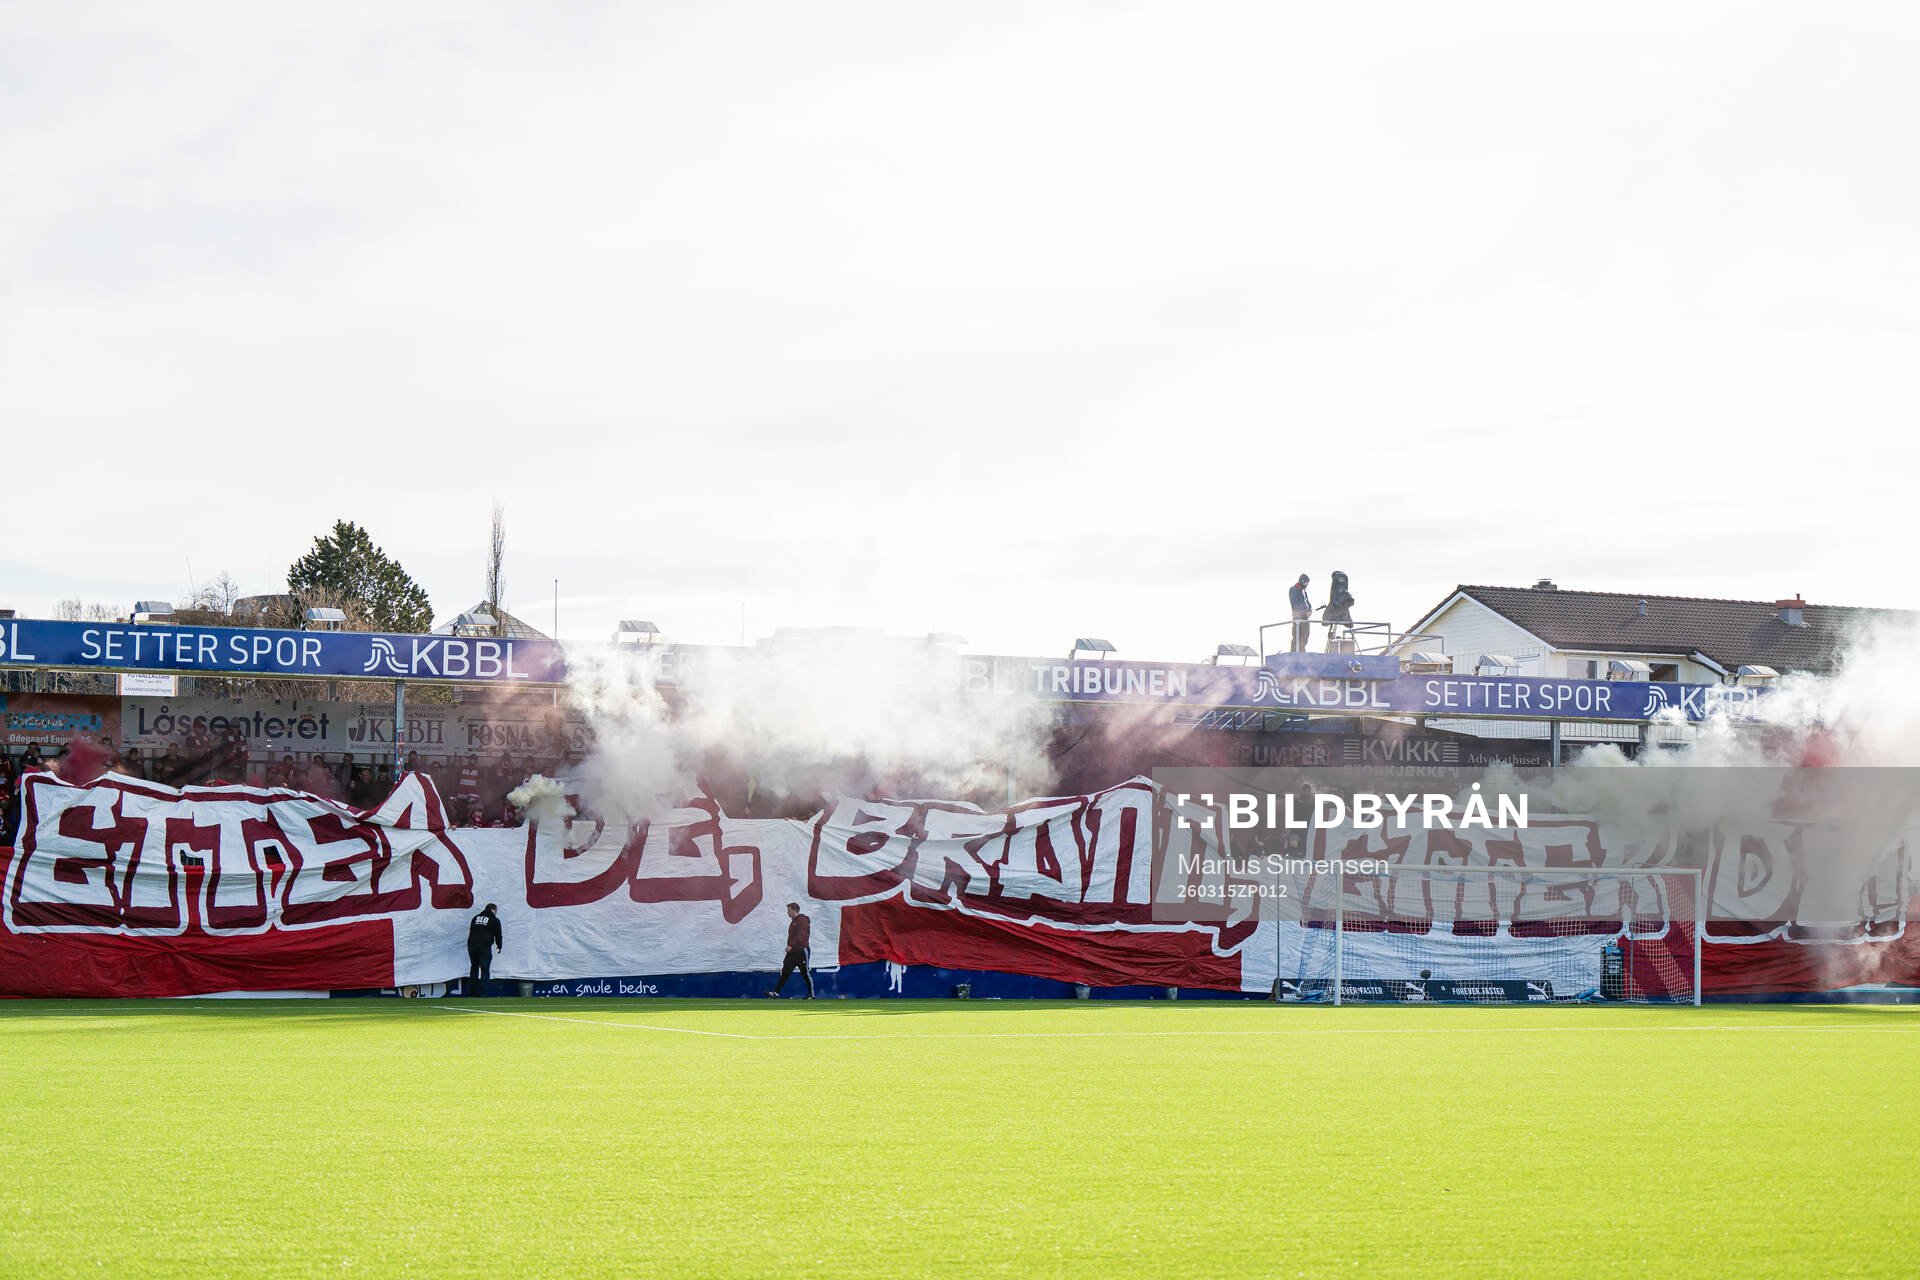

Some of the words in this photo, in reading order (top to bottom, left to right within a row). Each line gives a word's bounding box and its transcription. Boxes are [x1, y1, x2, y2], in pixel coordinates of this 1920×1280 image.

[0, 623, 35, 660] L
[80, 630, 218, 664] SETTER
[228, 635, 323, 667] SPOR
[411, 639, 529, 678] KBBL
[1031, 665, 1188, 697] TRIBUNEN
[1293, 679, 1391, 708] KBBL
[1425, 680, 1531, 709] SETTER
[1538, 684, 1612, 712] SPOR
[138, 705, 330, 740] Låssenteret
[1362, 739, 1440, 762] KVIKK
[575, 982, 613, 997] smule
[619, 980, 659, 995] bedre
